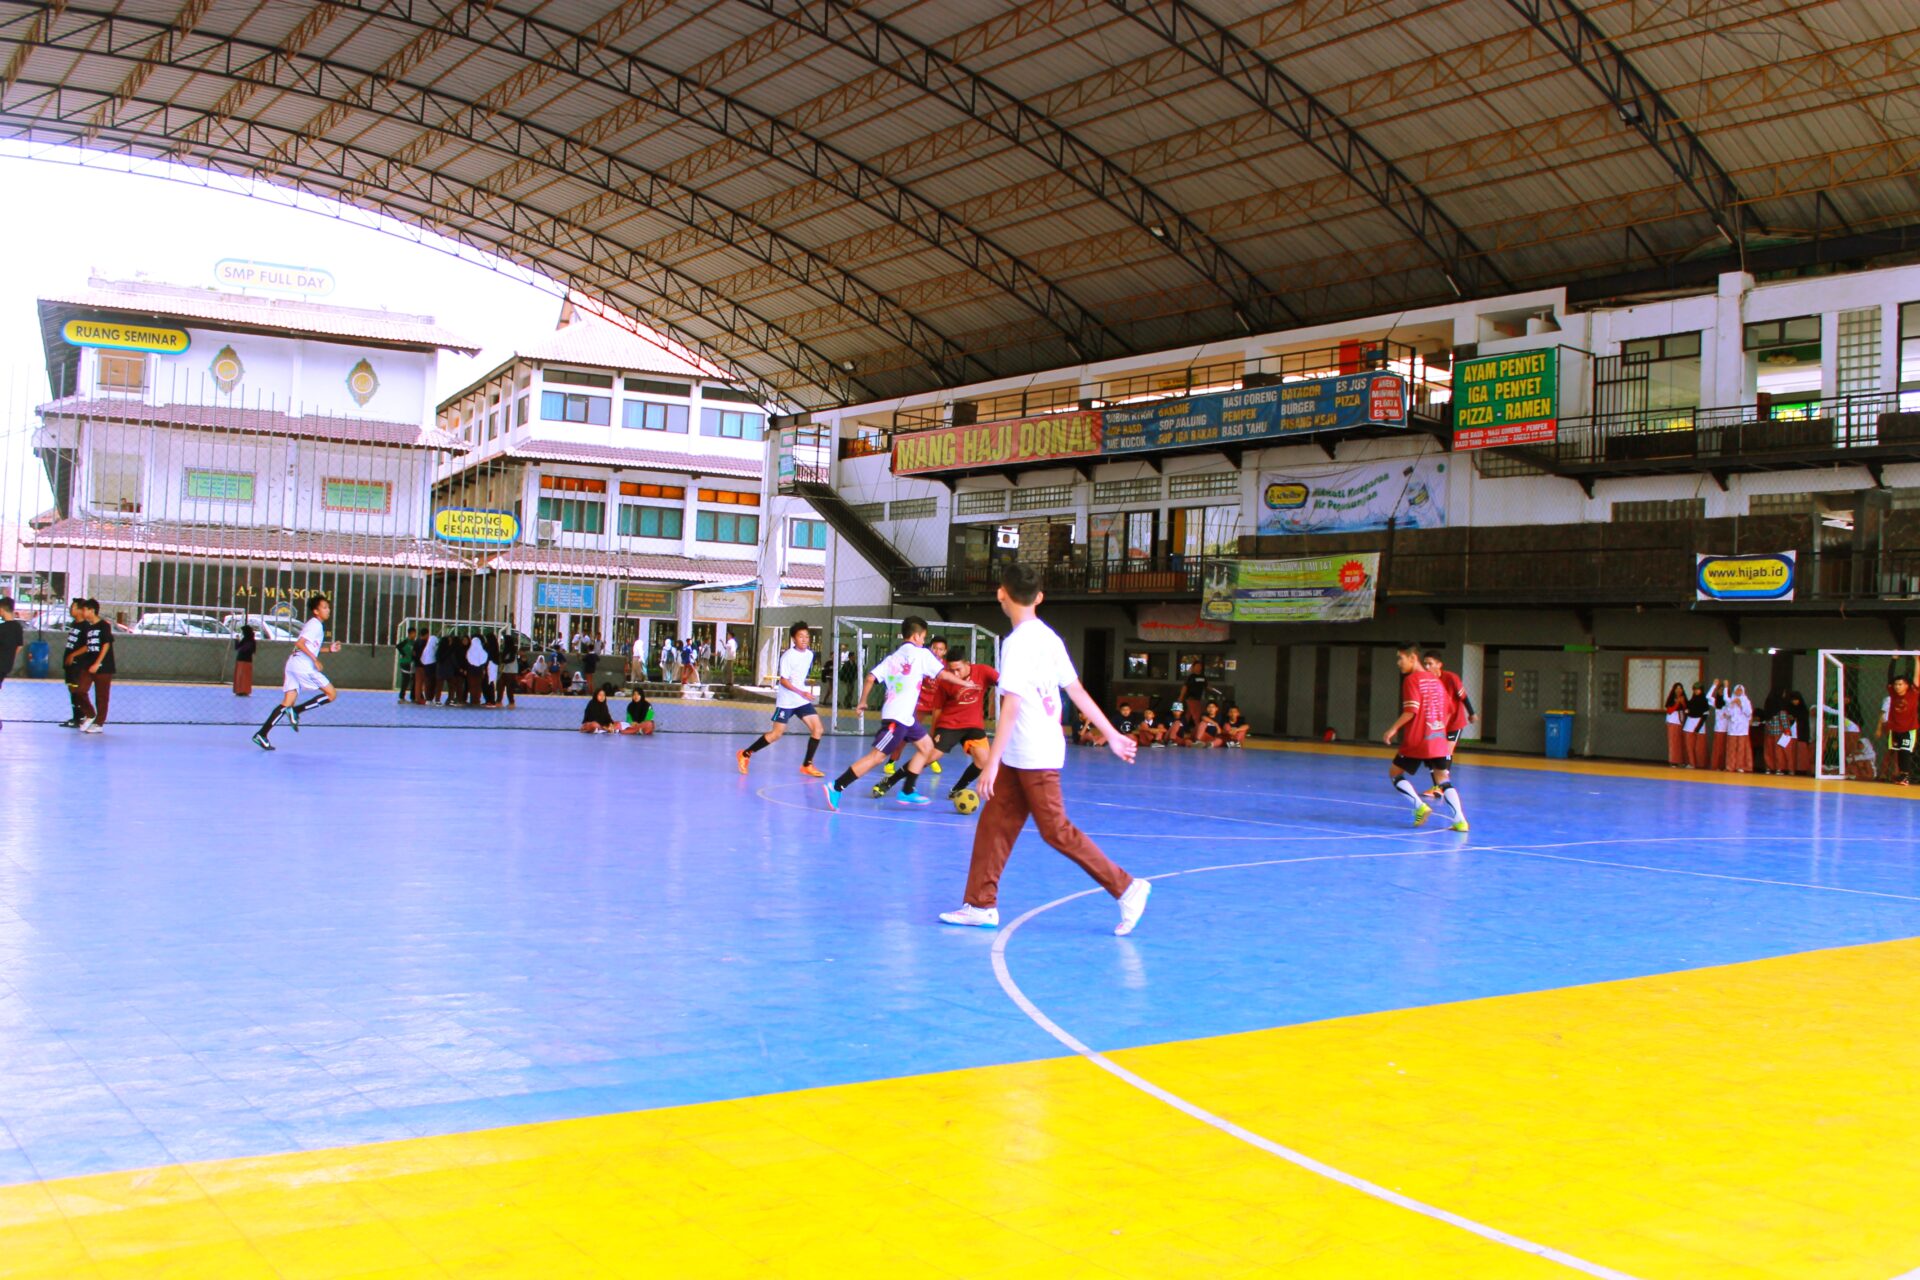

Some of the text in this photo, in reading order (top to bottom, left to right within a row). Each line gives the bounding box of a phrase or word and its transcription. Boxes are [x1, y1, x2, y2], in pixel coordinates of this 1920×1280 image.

[224, 266, 324, 288] SMP FULL DAY
[76, 326, 177, 346] RUANG SEMINAR
[1464, 354, 1546, 383] AYAM PENYET
[1282, 385, 1322, 400] BATAGOR
[1336, 378, 1367, 393] ES JUS
[1468, 376, 1542, 404] IGA PENYET
[1223, 391, 1278, 408] NASI GORENG
[1334, 394, 1360, 408] PIZZA
[1222, 408, 1258, 422] PEMPEK
[1281, 400, 1316, 416] BURGER
[1459, 406, 1494, 426] PIZZA
[1506, 398, 1551, 421] RAMEN
[1159, 420, 1174, 431] SOP
[1222, 422, 1268, 438] BASO TAHU
[1280, 416, 1312, 430] PISANG
[896, 416, 1096, 471] MANG HAJI DONAL
[1120, 436, 1146, 448] KOCOK
[452, 514, 502, 526] LORONG
[444, 524, 509, 537] PESANTREN
[1708, 566, 1783, 580] www.hijab.id
[236, 585, 256, 597] AL
